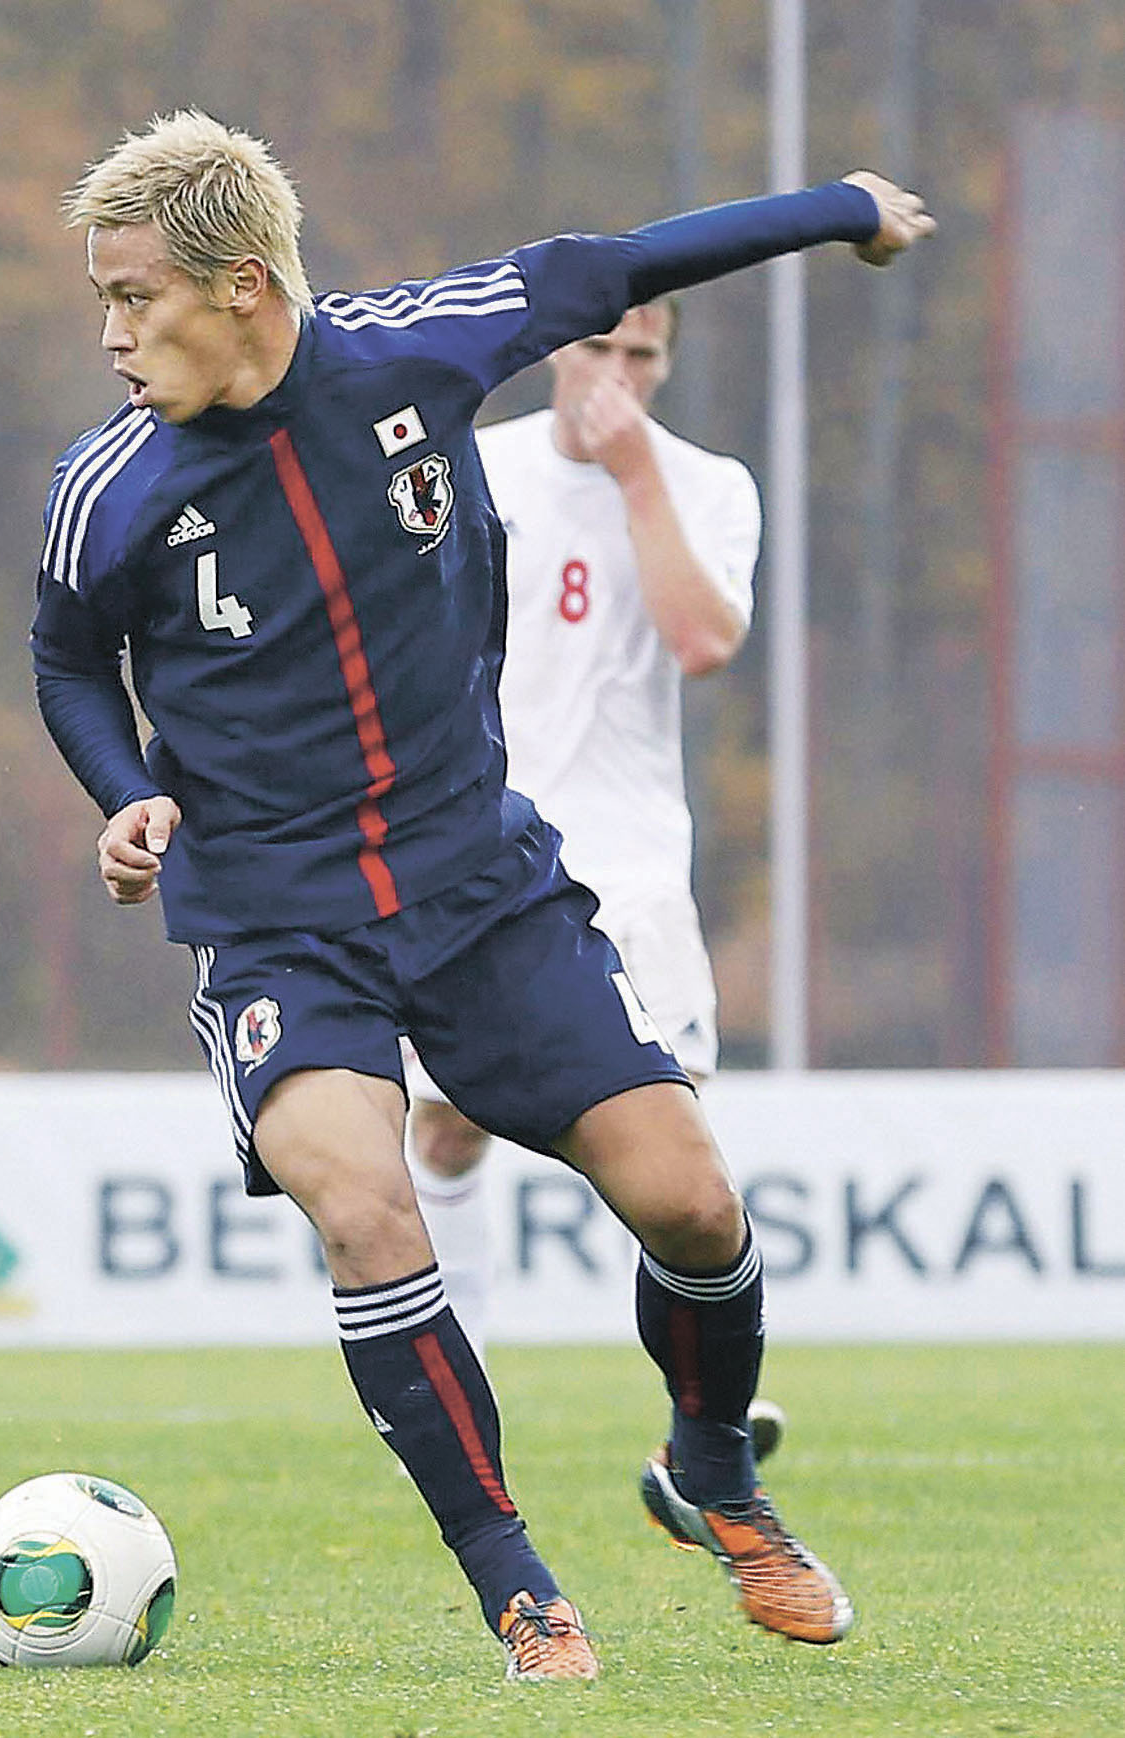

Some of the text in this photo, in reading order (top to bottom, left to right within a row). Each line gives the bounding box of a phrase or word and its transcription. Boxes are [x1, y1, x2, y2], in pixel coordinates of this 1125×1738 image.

[166, 521, 216, 547] adidas
[197, 551, 253, 639] 4
[560, 560, 588, 622] 8
[98, 1172, 1125, 1279] BERSKAL
